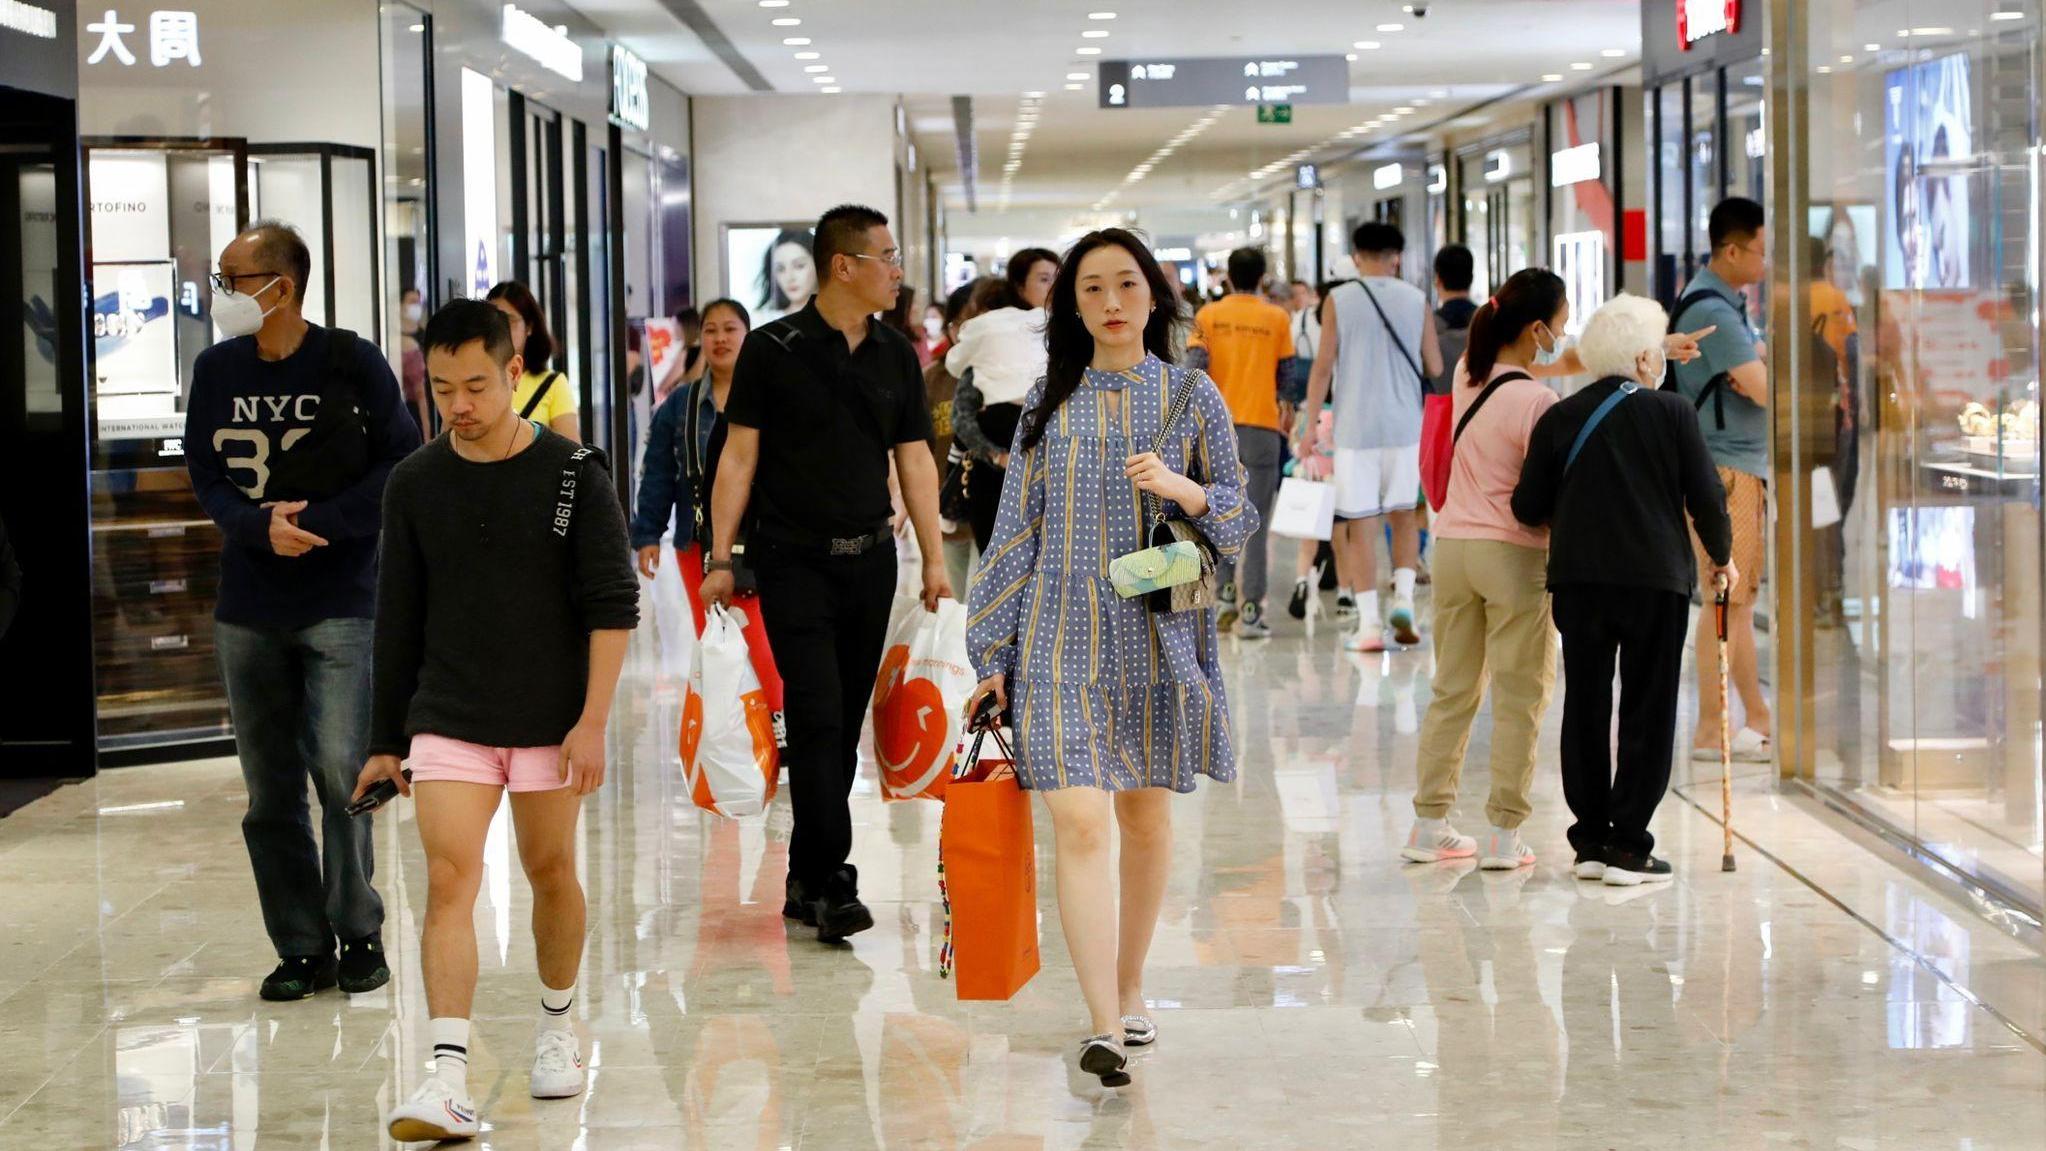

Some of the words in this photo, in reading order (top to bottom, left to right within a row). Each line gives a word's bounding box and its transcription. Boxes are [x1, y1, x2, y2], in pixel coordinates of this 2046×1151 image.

[231, 394, 321, 423] NYC
[162, 422, 186, 430] WATC
[212, 428, 312, 499] 3
[552, 502, 573, 537] 1987
